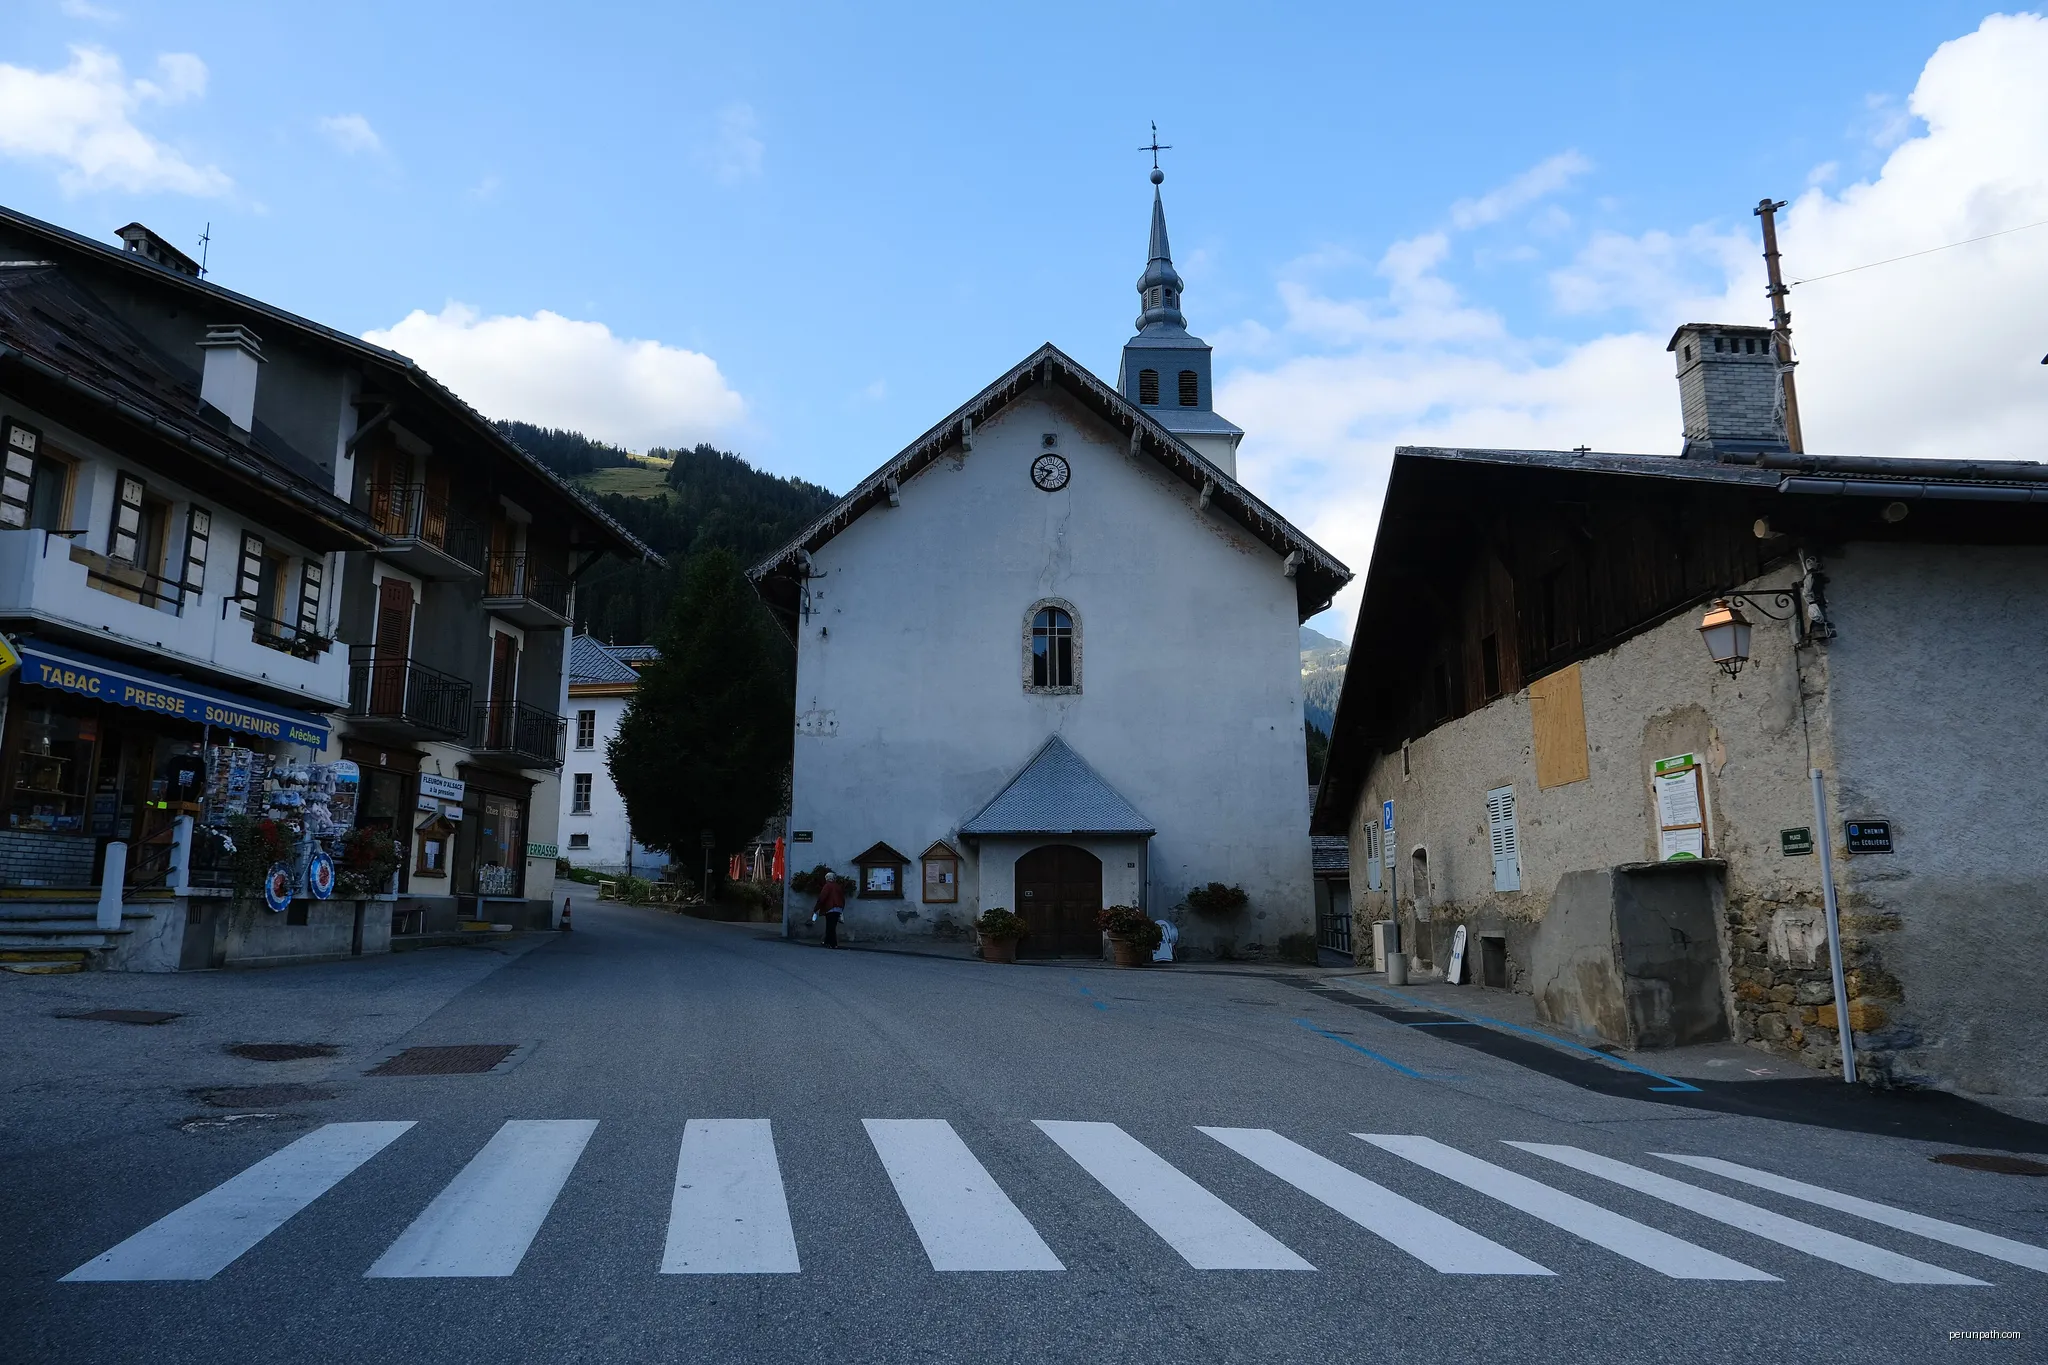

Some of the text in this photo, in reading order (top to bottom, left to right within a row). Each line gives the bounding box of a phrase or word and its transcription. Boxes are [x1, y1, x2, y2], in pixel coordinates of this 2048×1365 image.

[40, 664, 100, 693] TABAC
[125, 686, 185, 714] PRESSE
[205, 706, 280, 736] SOUVENIRS
[289, 726, 320, 745] Arêches
[423, 776, 463, 791] FLEURON D'ALSACE
[438, 789, 455, 797] pression
[1789, 833, 1801, 841] PLACE
[528, 843, 556, 857] TERRASSE
